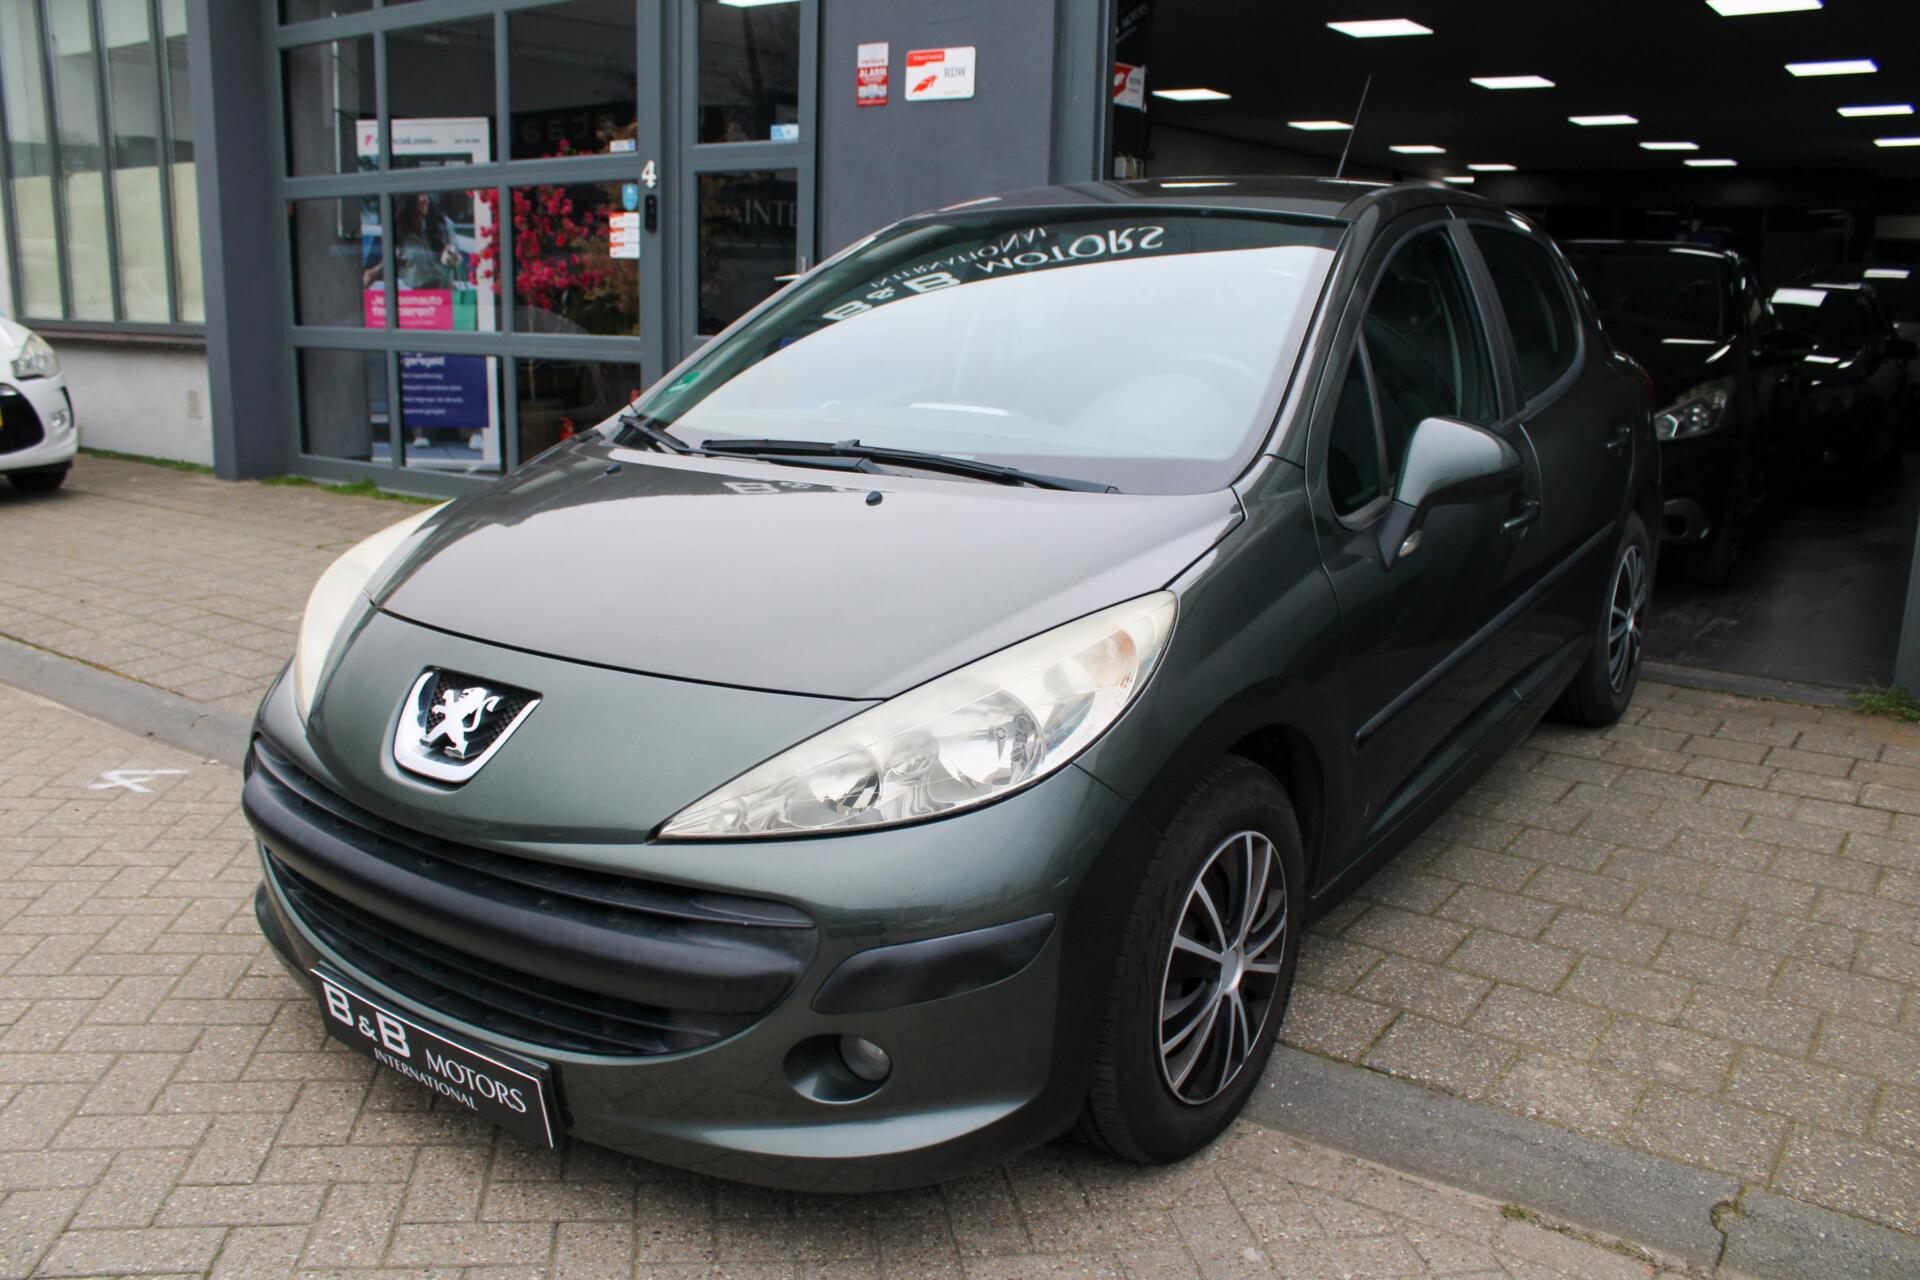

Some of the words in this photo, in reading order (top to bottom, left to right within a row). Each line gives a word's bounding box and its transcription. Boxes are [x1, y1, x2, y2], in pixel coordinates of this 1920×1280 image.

[641, 160, 657, 188] 4
[373, 1047, 479, 1111] INTERNATIONAL
[425, 1048, 527, 1113] MOTORS
